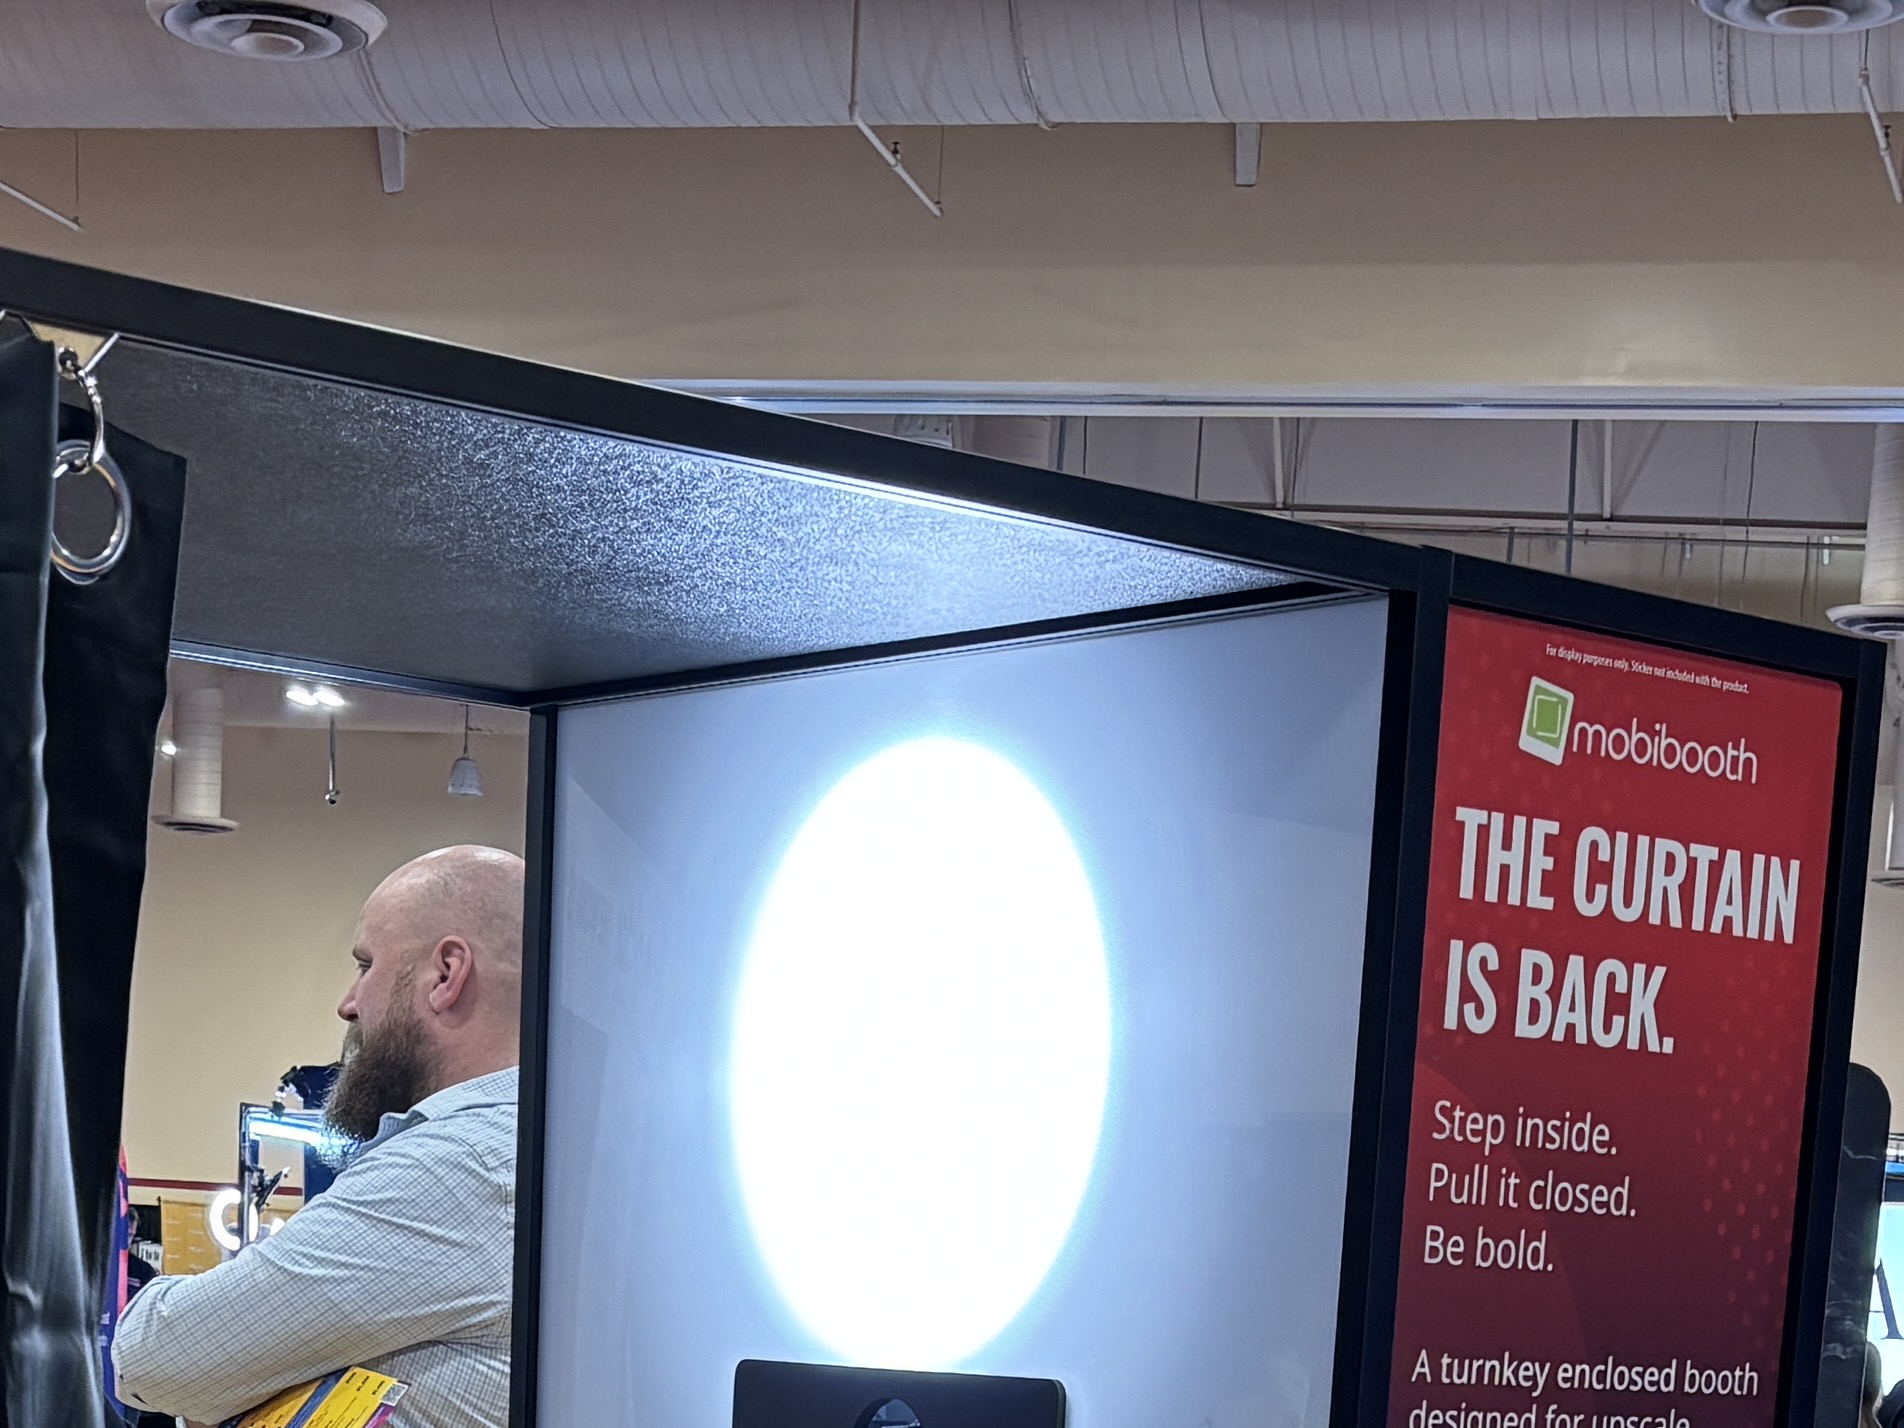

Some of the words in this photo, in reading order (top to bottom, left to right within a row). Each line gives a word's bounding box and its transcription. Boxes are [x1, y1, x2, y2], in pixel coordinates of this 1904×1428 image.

[1572, 718, 1758, 784] mobibooth
[1455, 806, 1560, 911] THE
[1573, 827, 1800, 944] CURTAIN
[1443, 940, 1499, 1035] IS
[1515, 948, 1674, 1054] BACK.
[1432, 1099, 1505, 1155] Step
[1515, 1107, 1618, 1155] inside.
[1429, 1163, 1487, 1206] Pull
[1499, 1168, 1519, 1208] it
[1528, 1172, 1637, 1217] closed.
[1423, 1225, 1465, 1266] Be
[1475, 1227, 1554, 1271] bold.
[1411, 1349, 1431, 1383] A
[1441, 1352, 1549, 1398] turnkey
[1556, 1357, 1676, 1392] enclosed
[1684, 1359, 1759, 1396] booth
